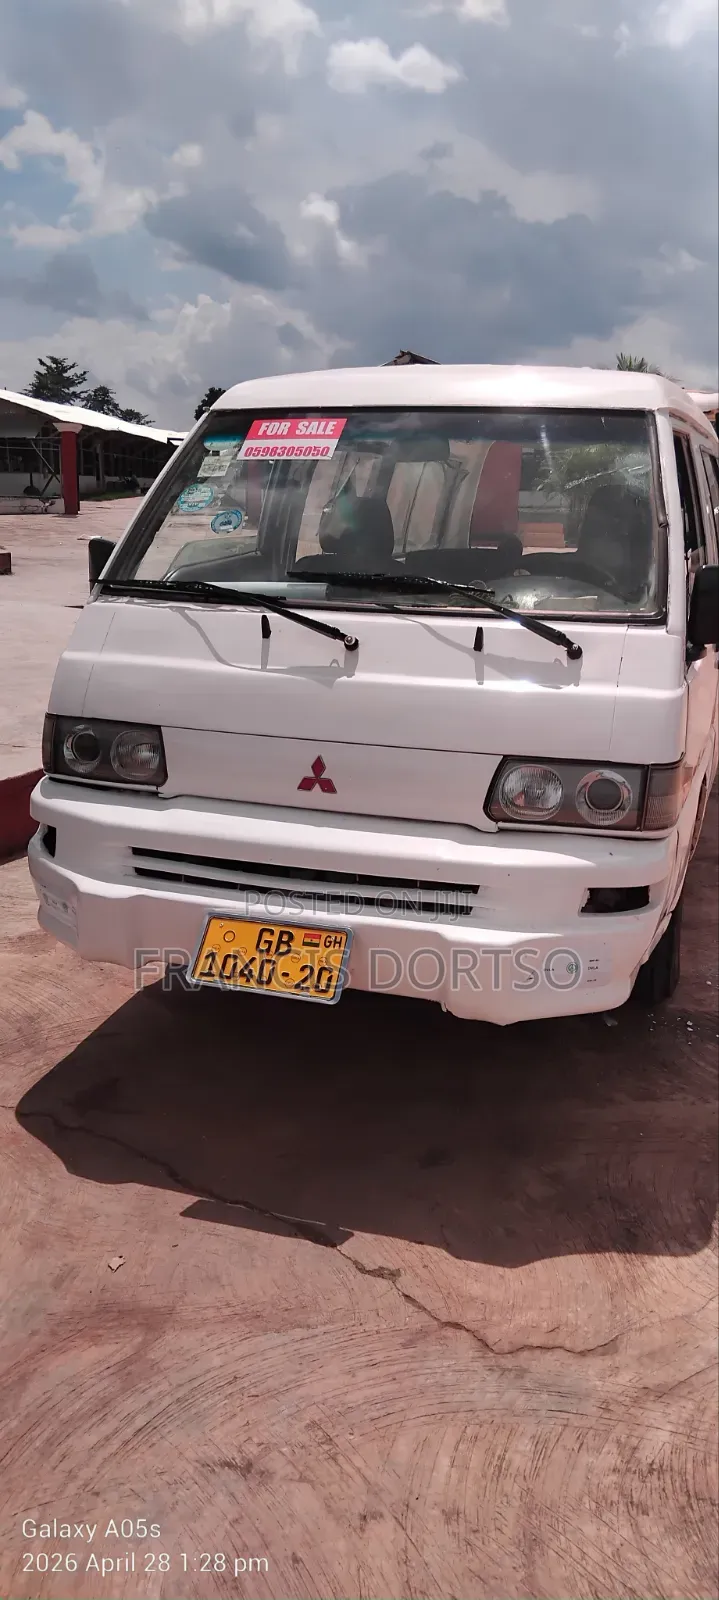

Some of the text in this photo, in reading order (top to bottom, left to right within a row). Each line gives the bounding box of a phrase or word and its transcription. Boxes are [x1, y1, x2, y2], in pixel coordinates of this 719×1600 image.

[258, 421, 337, 435] FOR SALE
[244, 446, 330, 457] 0598305050
[255, 927, 343, 956] GB GH
